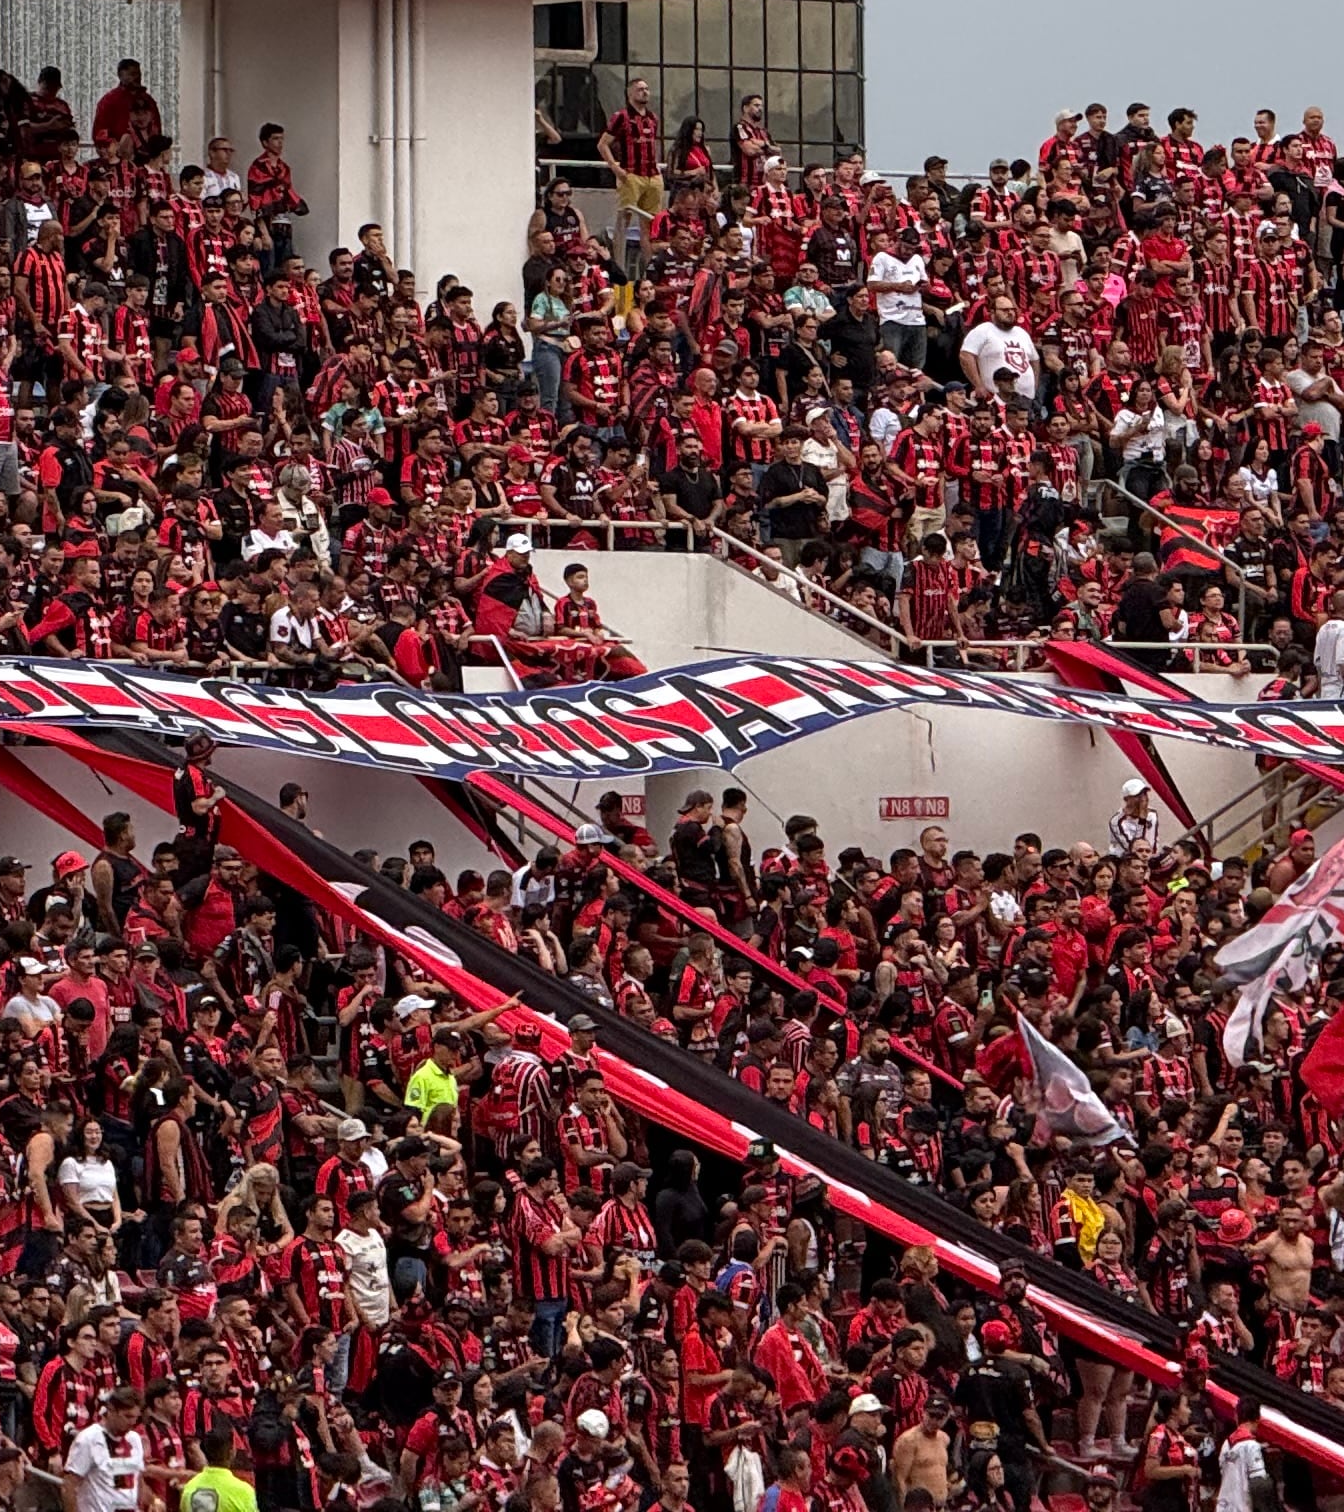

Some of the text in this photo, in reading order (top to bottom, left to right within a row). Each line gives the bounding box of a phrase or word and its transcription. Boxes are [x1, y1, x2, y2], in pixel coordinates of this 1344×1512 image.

[621, 796, 642, 814] N8
[891, 799, 945, 816] N8 N8
